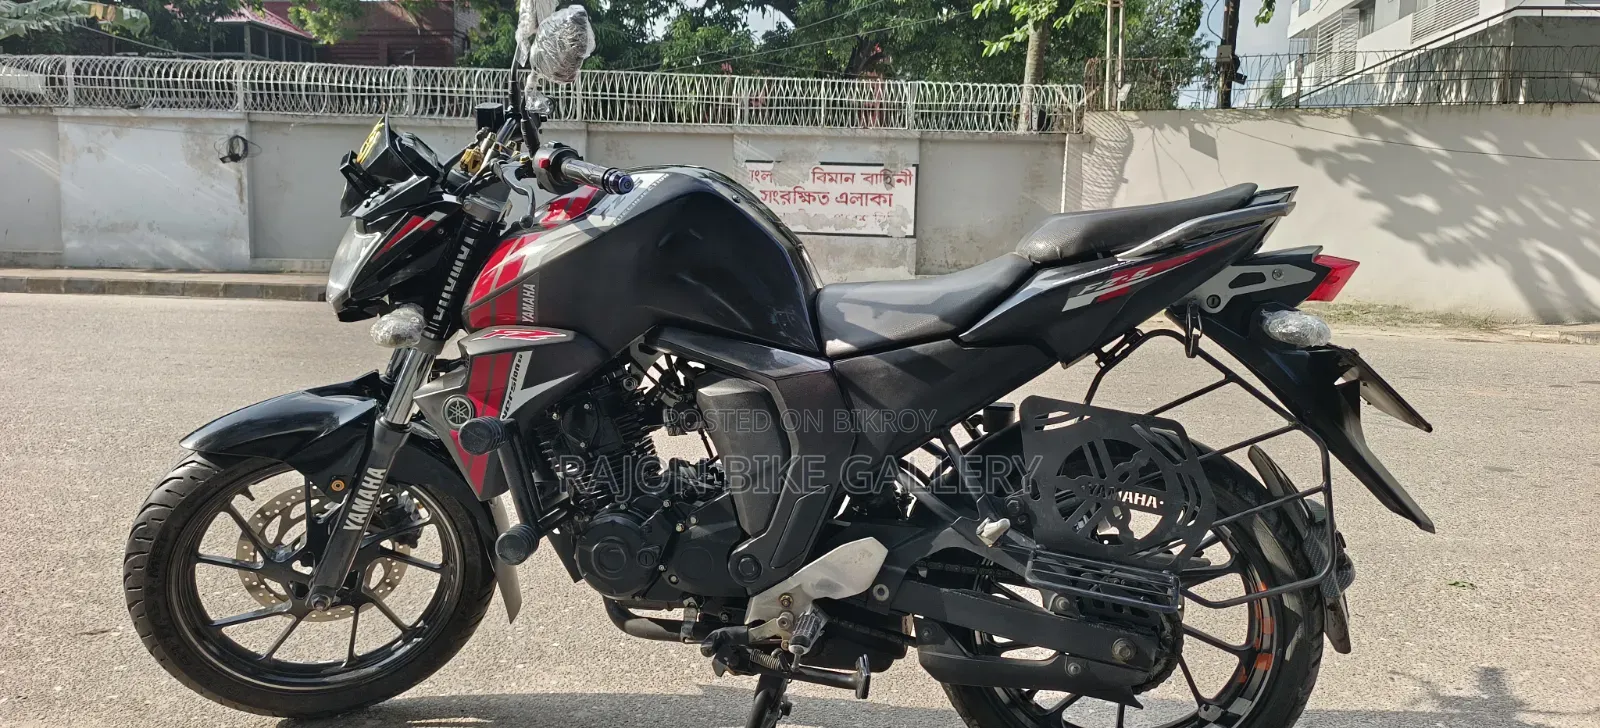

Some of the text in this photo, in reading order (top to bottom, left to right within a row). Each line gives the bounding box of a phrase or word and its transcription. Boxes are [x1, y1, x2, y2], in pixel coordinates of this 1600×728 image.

[811, 166, 855, 184] বিমান
[760, 185, 893, 207] সংরক্ষিত এলাকা
[521, 283, 536, 323] YAMAHA
[343, 467, 387, 531] YAMAHA
